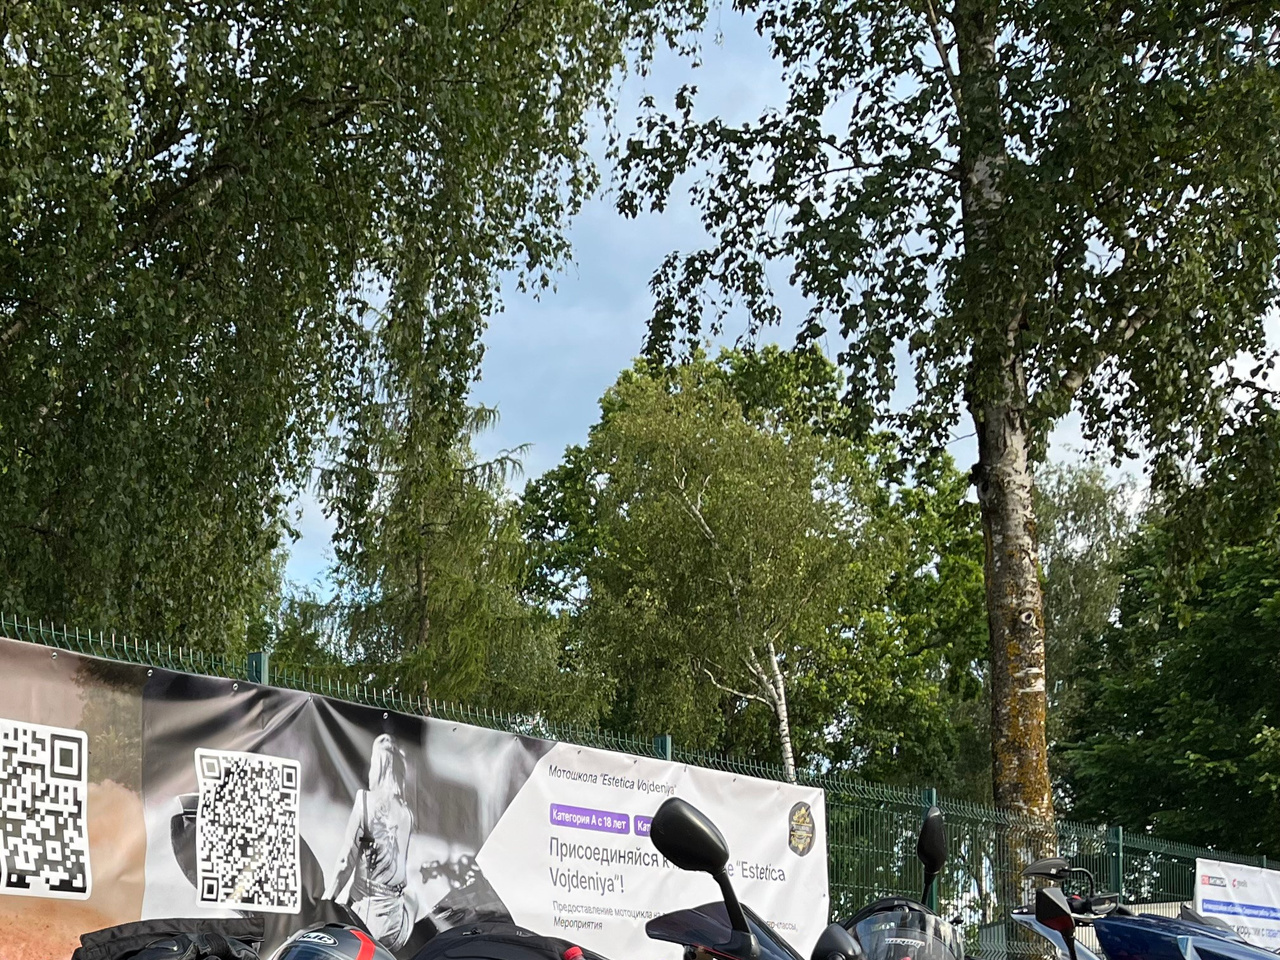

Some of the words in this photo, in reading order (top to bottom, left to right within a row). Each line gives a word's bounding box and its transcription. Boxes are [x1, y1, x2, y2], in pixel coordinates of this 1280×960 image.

[548, 764, 598, 784] Мотошкола
[552, 808, 591, 827] Категория
[603, 816, 612, 828] 18
[612, 820, 627, 830] лет
[549, 836, 660, 868] Присоединяйся
[552, 900, 614, 917] Предоставление
[614, 909, 653, 920] мотоцикла
[553, 916, 603, 931] Мероприятия
